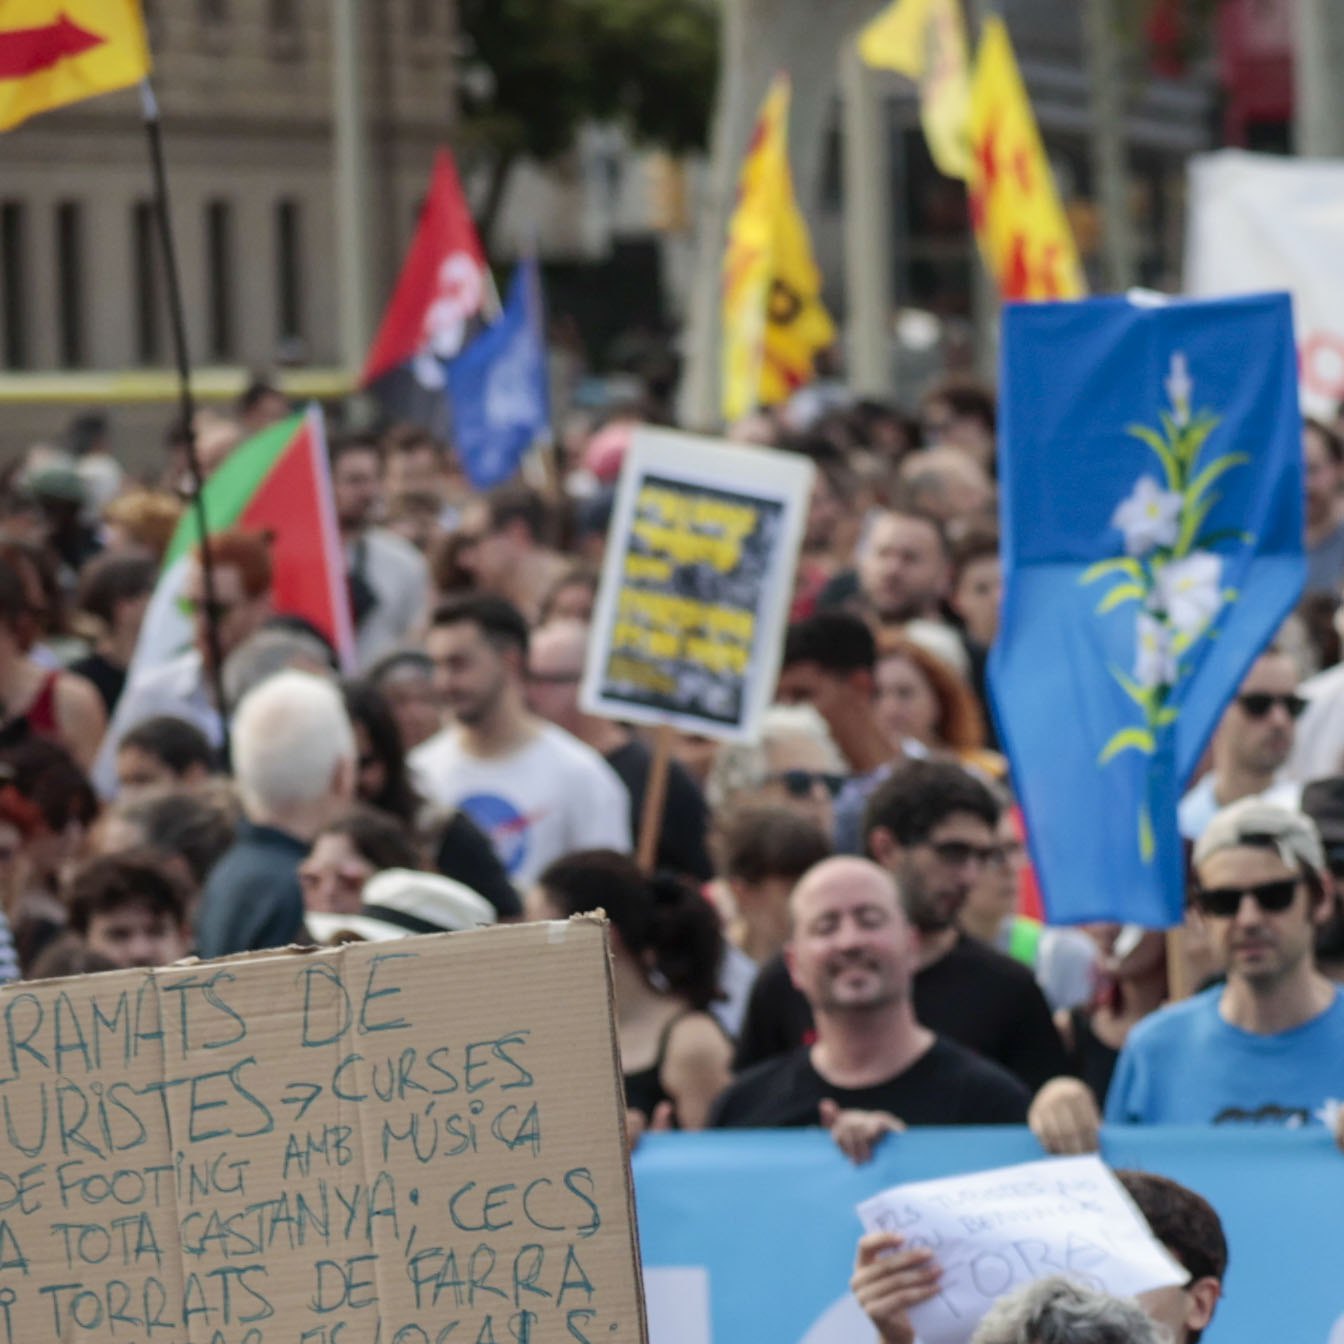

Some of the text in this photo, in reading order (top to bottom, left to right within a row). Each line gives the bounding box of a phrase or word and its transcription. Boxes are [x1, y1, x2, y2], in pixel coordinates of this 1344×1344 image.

[302, 953, 418, 1048] DE
[331, 1031, 535, 1102] CURSES
[283, 1125, 353, 1180] AMB
[51, 1212, 165, 1274] TOTA
[449, 1167, 601, 1239] CECS
[39, 1264, 275, 1338] TORRATS
[308, 1254, 379, 1314] DE
[408, 1243, 596, 1309] FARRA
